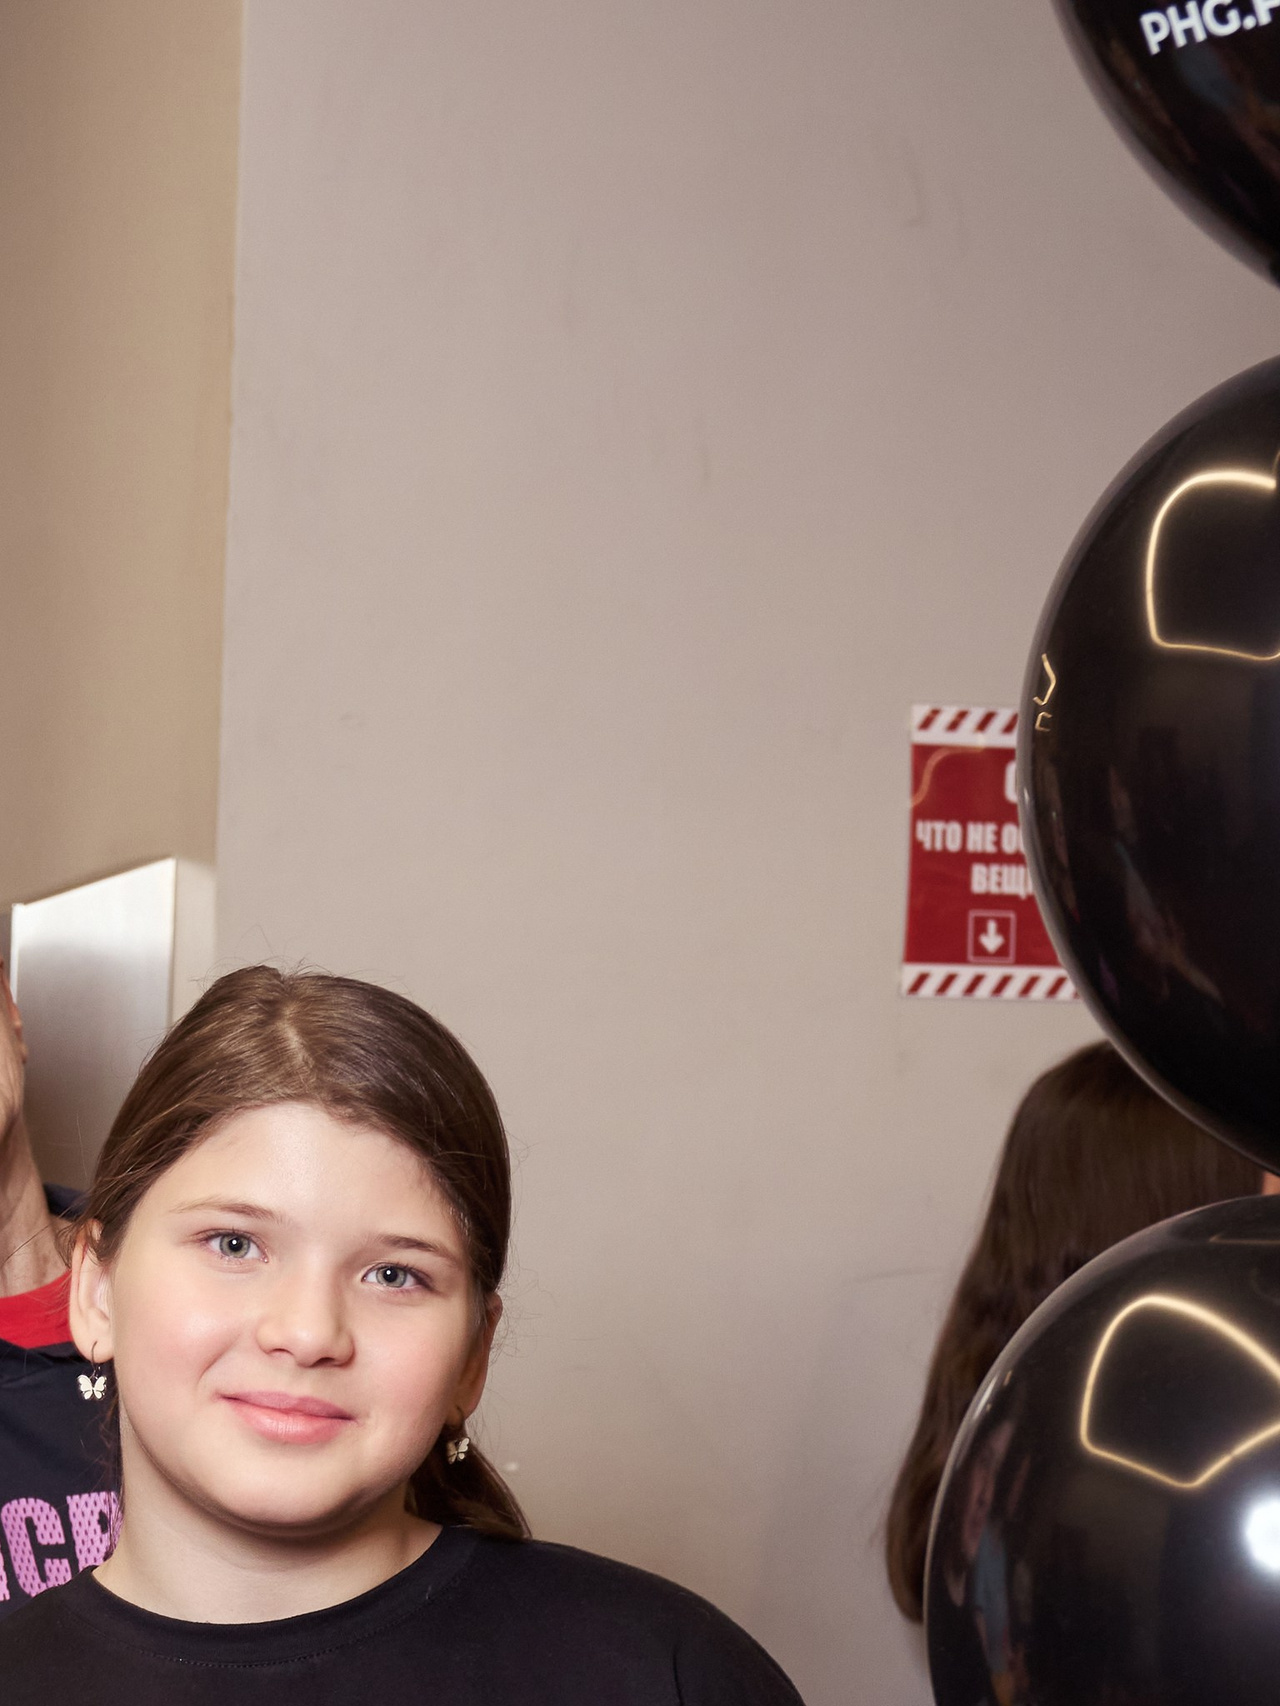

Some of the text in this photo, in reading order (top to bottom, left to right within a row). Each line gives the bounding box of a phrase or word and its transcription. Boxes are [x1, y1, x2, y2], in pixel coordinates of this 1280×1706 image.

[916, 820, 1026, 855] ЧТО НЕ О
